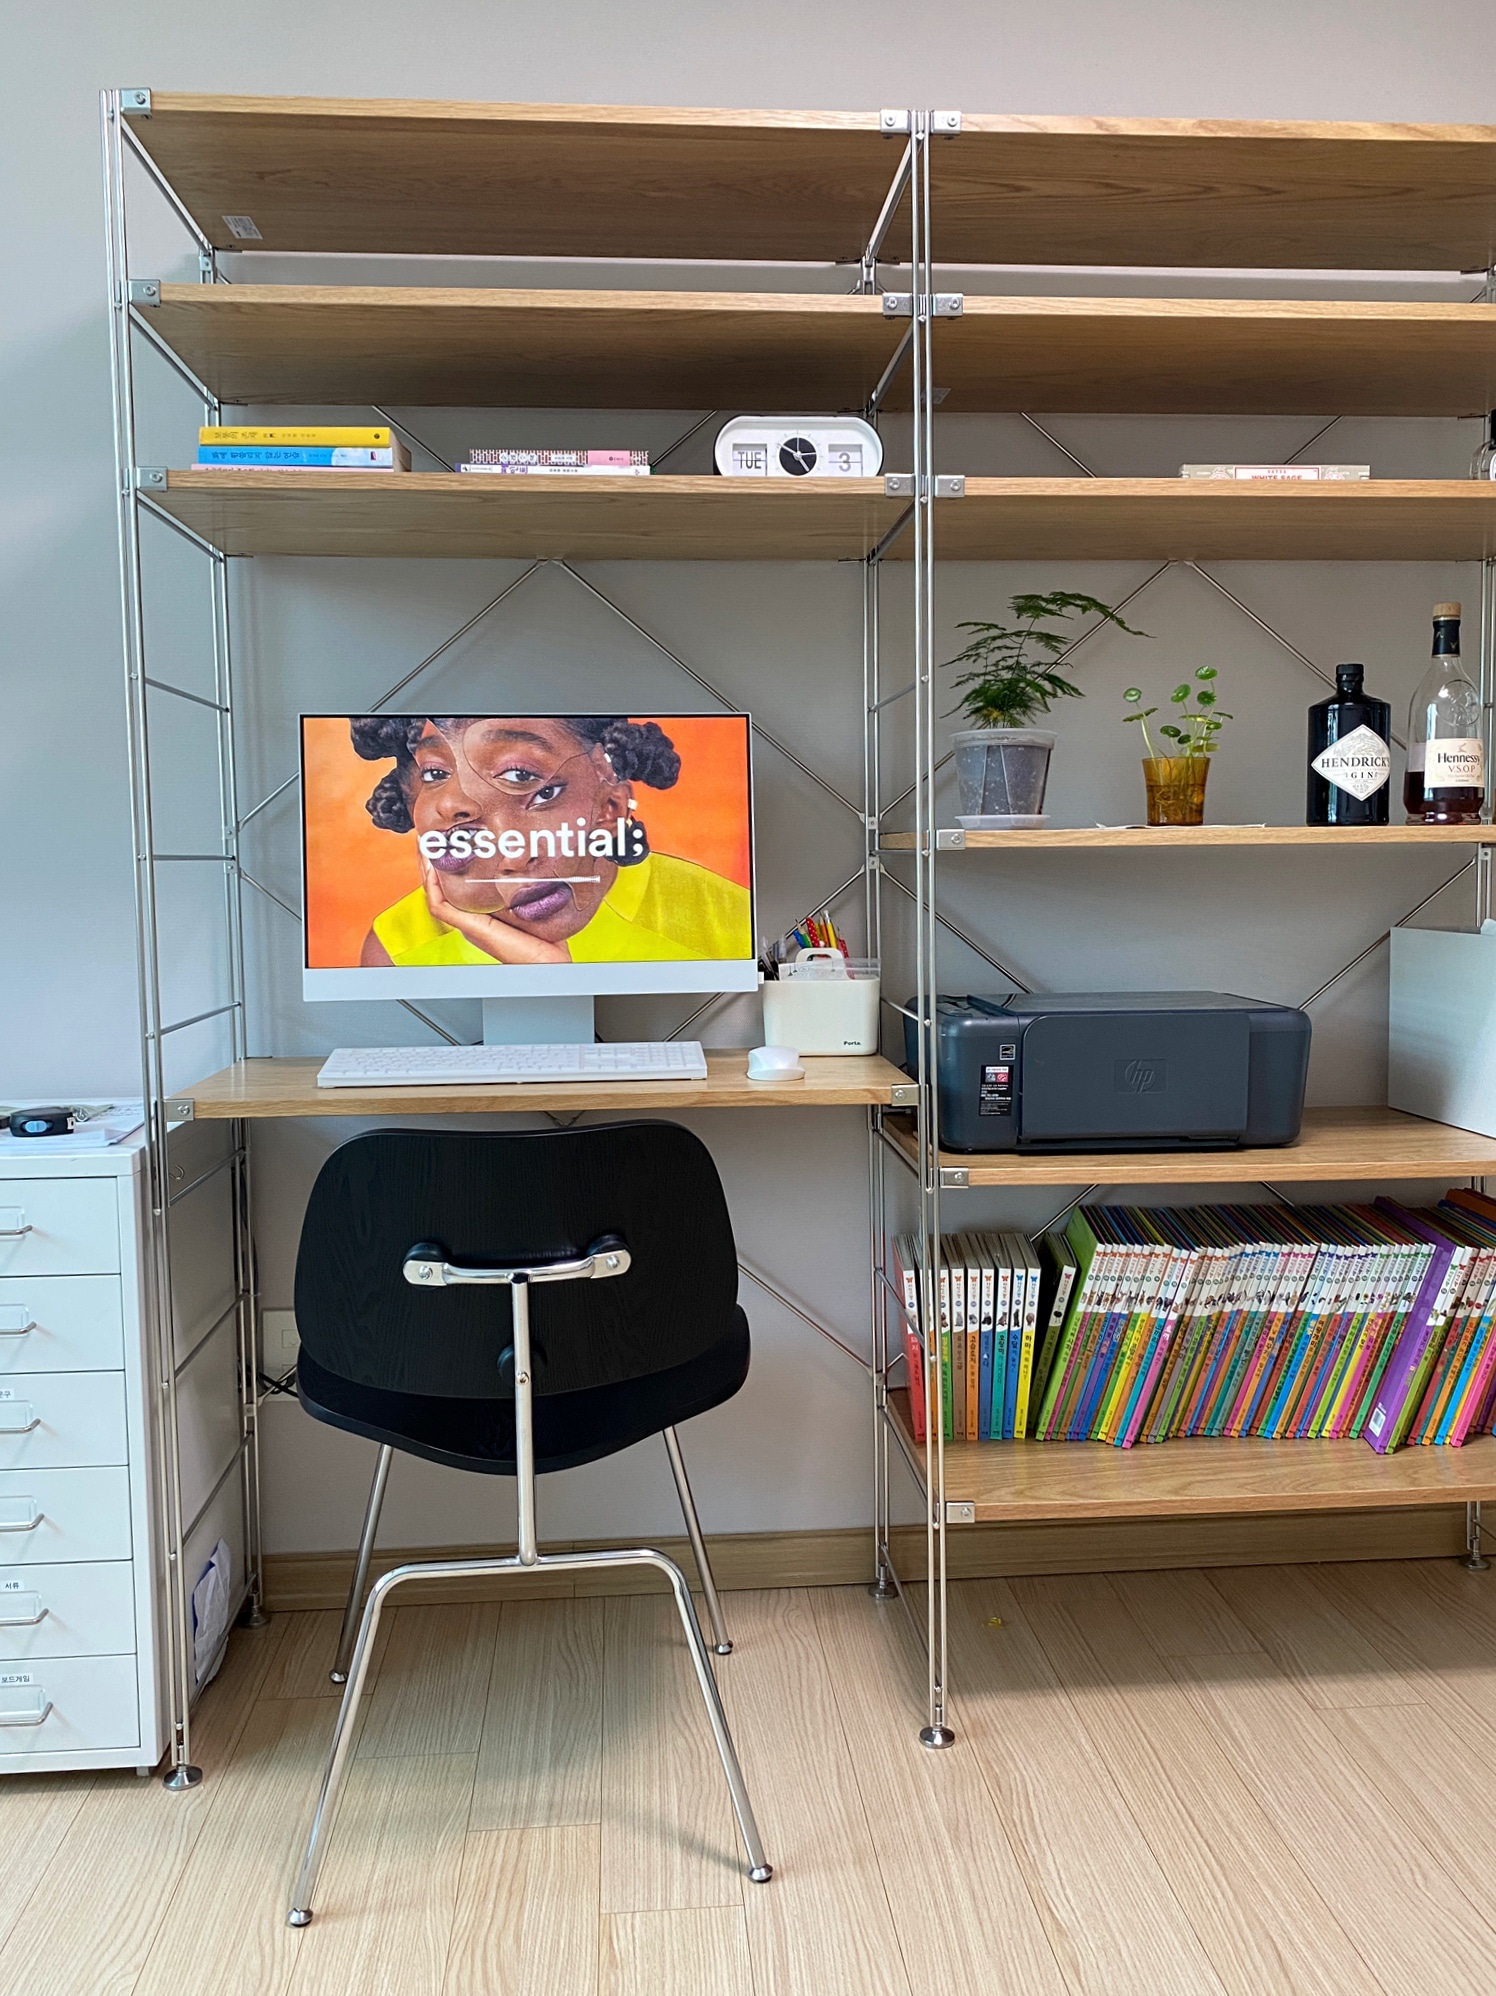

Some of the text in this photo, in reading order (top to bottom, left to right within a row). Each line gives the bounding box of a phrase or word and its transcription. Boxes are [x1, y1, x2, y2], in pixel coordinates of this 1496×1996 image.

[738, 451, 762, 470] TUE
[838, 452, 851, 472] 3
[1321, 756, 1390, 768] HENDRICK
[1437, 752, 1480, 766] Hennessy
[1350, 771, 1374, 779] GIN
[418, 816, 644, 859] essential;
[5, 1582, 19, 1590] 서류
[1, 1675, 30, 1683] 보드게임
